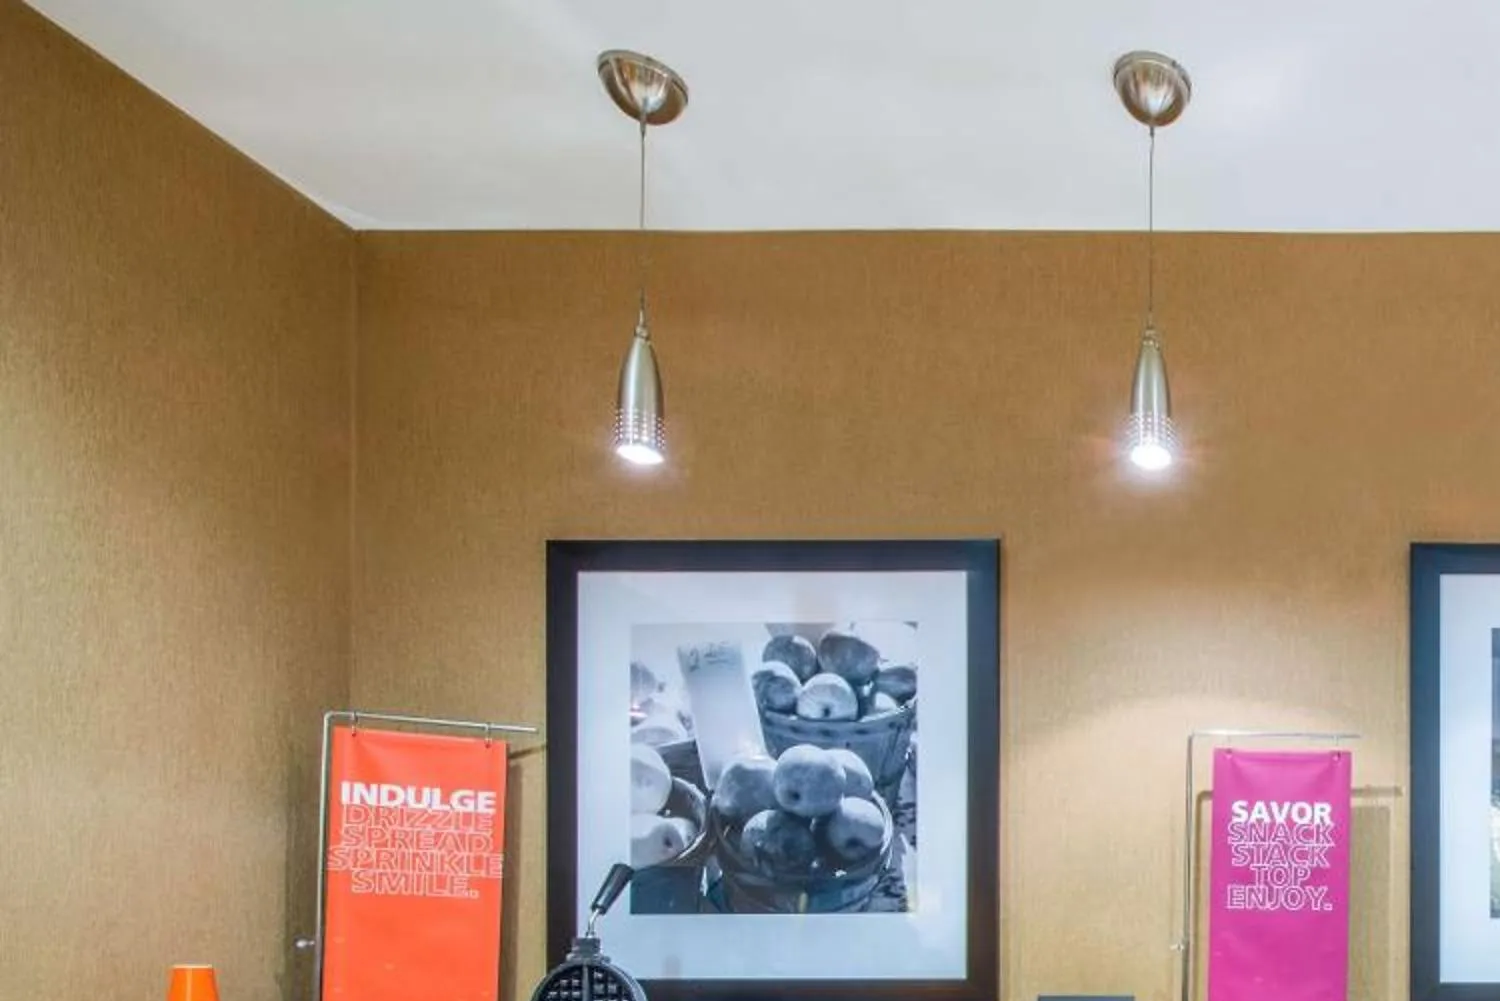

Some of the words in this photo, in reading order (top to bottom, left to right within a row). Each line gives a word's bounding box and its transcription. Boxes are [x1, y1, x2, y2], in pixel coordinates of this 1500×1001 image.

[340, 781, 498, 815] INDULGE
[343, 804, 493, 833] DRIZZLE
[1231, 800, 1332, 825] SAVOR
[342, 825, 494, 853] SPREAD
[1227, 821, 1335, 847] SNACK
[327, 845, 505, 879] SPRINKLE
[1231, 842, 1331, 868] STACK
[351, 869, 480, 899] SMILE.
[1249, 863, 1312, 888] TOP
[1226, 884, 1334, 911] ENJOY.
